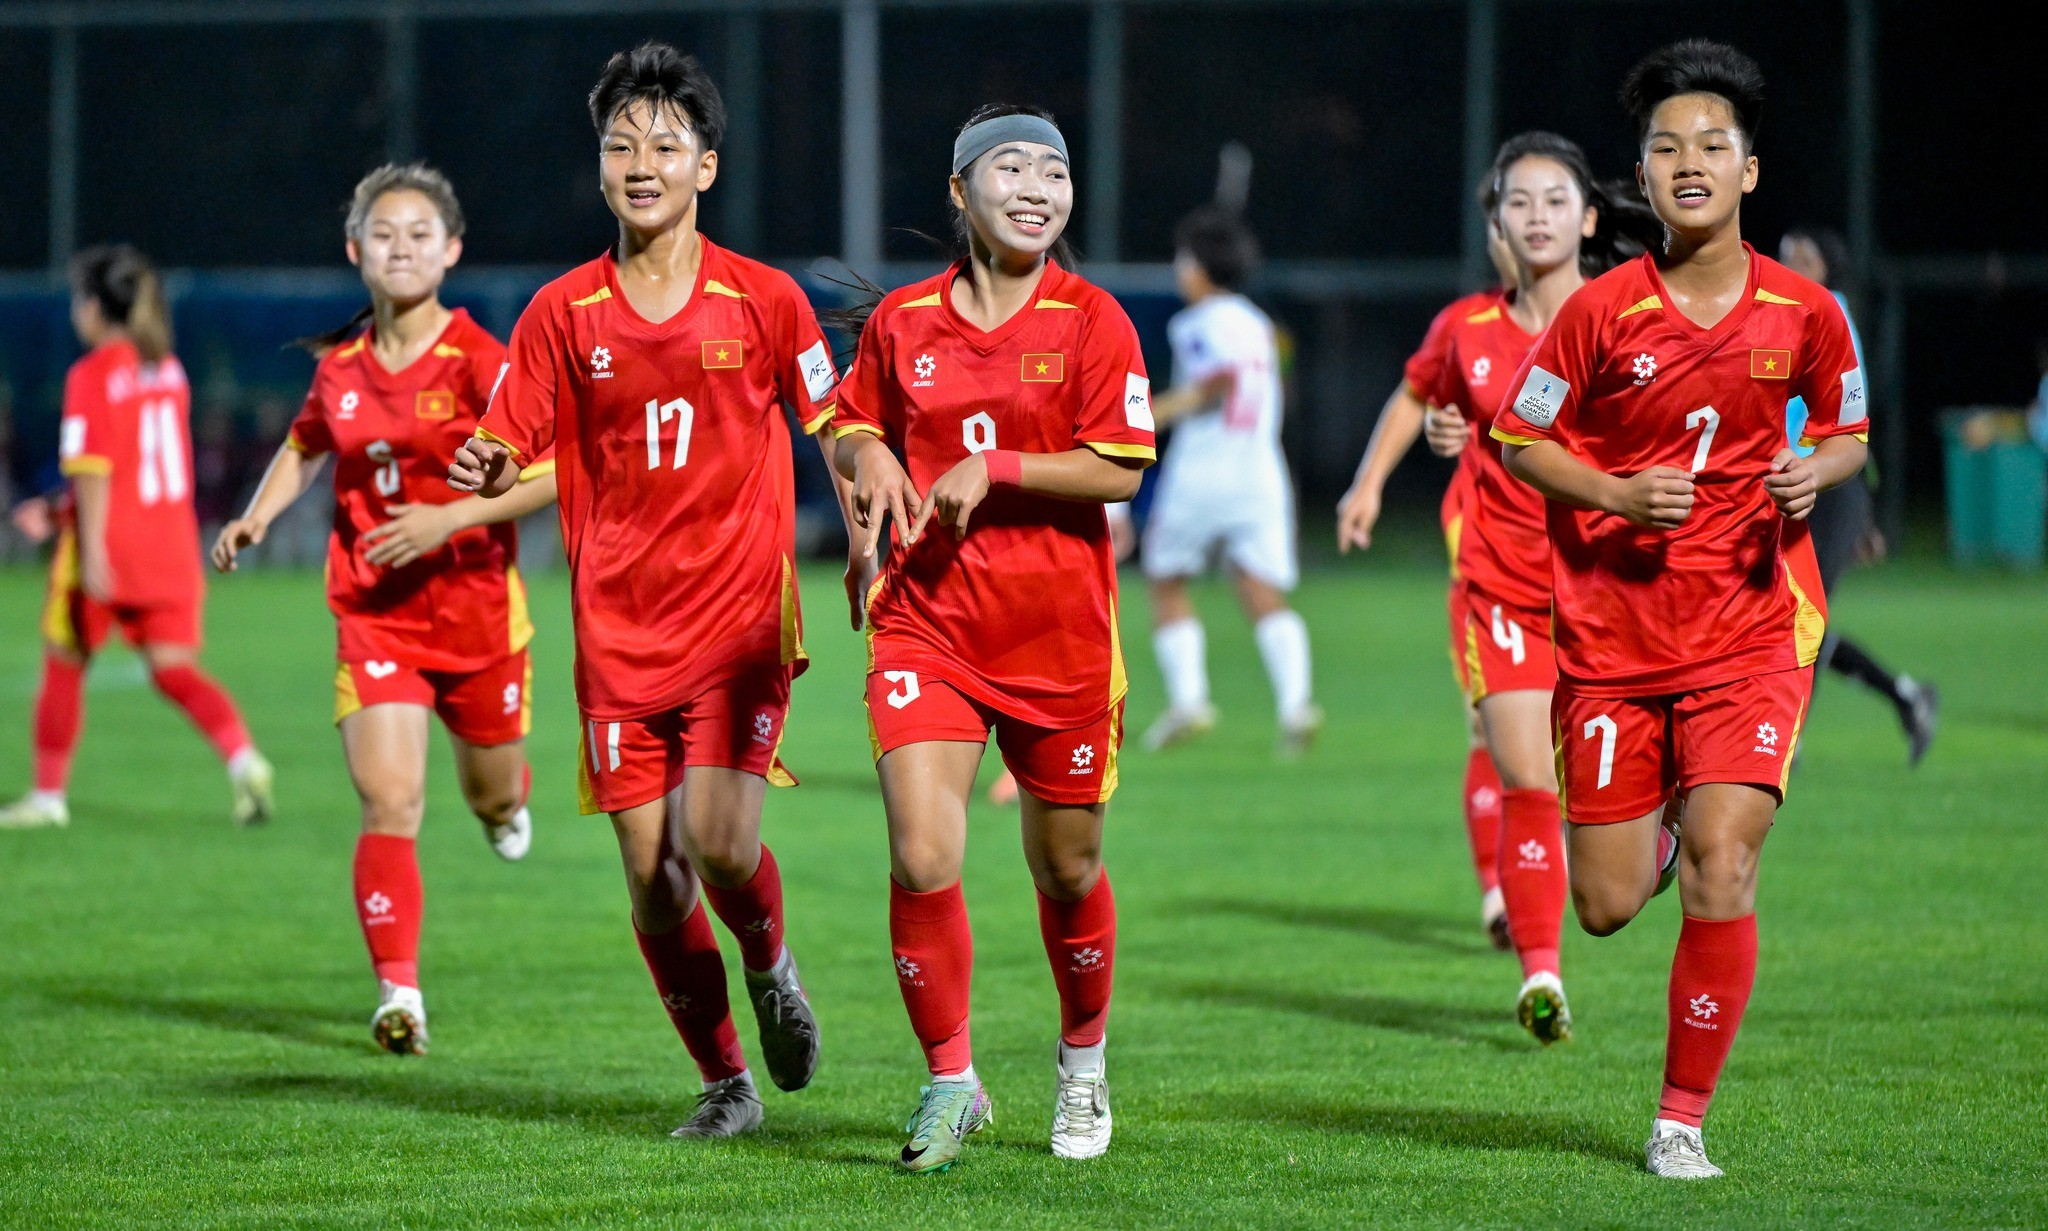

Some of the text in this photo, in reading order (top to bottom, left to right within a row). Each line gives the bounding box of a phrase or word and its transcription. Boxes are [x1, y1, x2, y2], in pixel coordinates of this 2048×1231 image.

[1520, 403, 1537, 414] ASIAN
[1538, 411, 1550, 419] CUP
[1528, 396, 1540, 404] AFC
[645, 397, 694, 471] 17
[1686, 405, 1720, 474] 7
[1491, 604, 1526, 666] 4
[1584, 714, 1617, 790] 7
